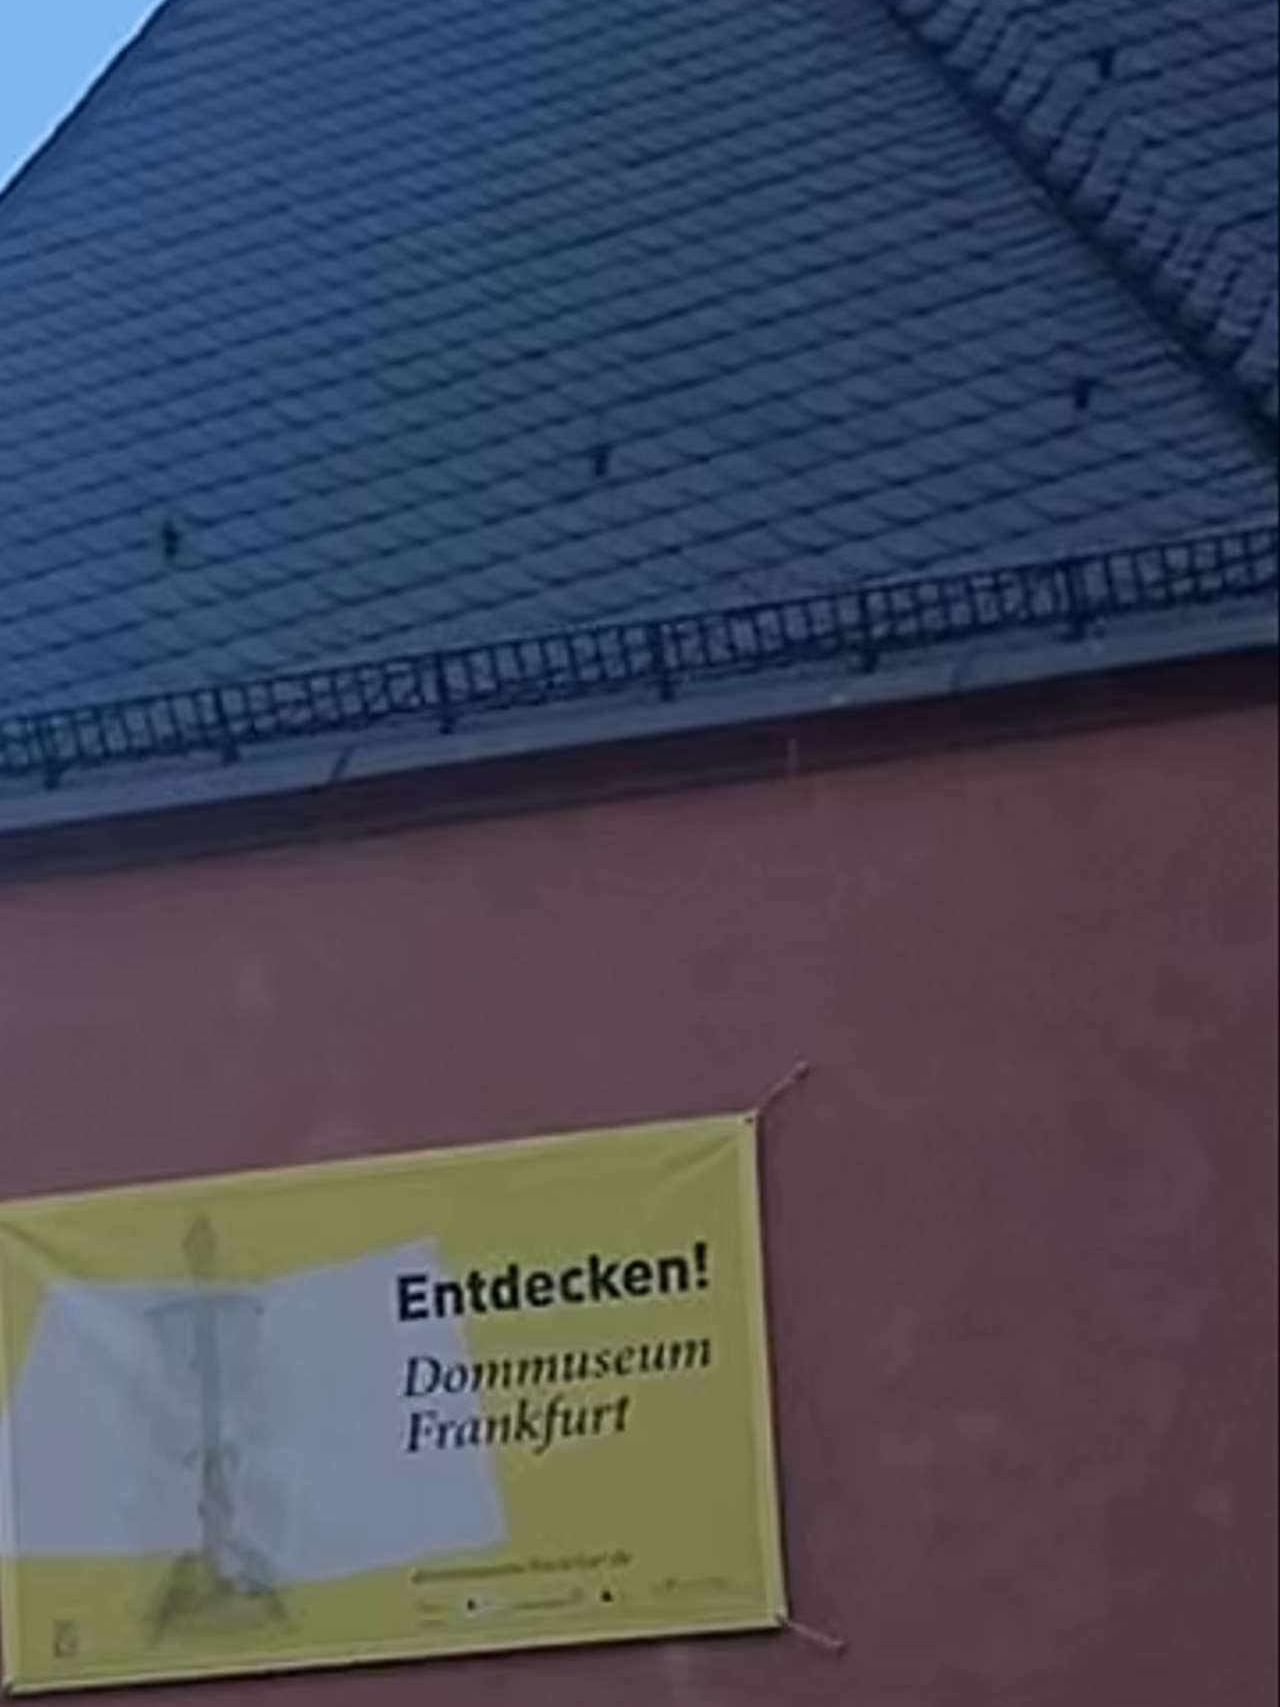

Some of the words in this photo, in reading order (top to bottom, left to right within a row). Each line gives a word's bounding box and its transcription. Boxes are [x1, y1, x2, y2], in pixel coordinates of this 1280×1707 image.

[396, 1241, 709, 1323] Entdecken!
[403, 1338, 711, 1398] Dommuseum
[403, 1394, 630, 1456] Frankfurt
